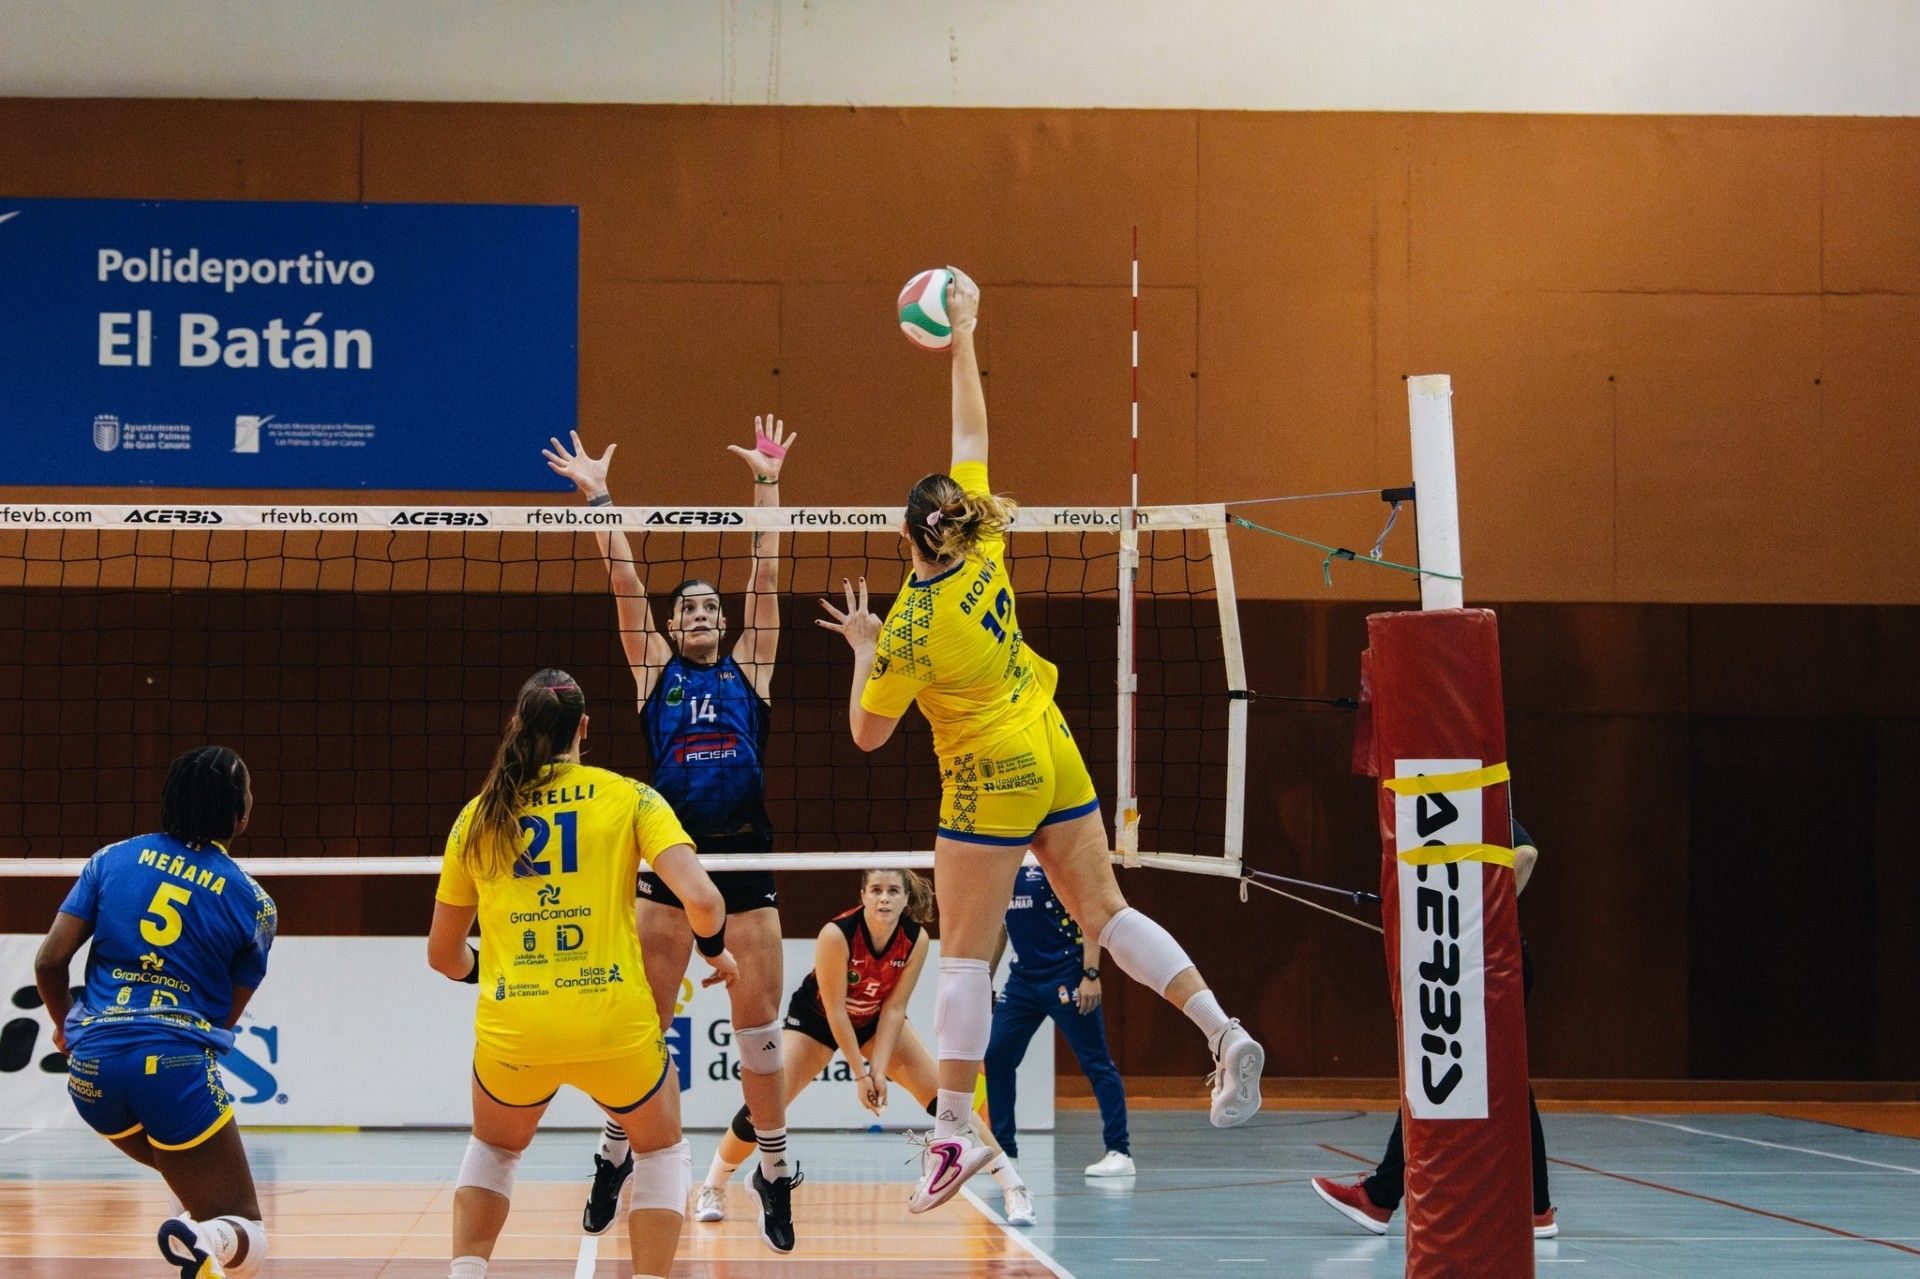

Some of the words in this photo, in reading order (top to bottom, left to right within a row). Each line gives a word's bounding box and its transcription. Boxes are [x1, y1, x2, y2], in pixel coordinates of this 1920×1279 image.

[98, 248, 375, 292] Polideportivo
[98, 310, 152, 366] El
[180, 312, 373, 369] Batán
[261, 507, 358, 524] rfevb.com
[526, 508, 622, 525] rfevb.com
[790, 508, 887, 526] rfevb.com
[1054, 509, 1148, 525] rfevb.cm
[690, 694, 717, 724] 14
[1014, 775, 1045, 788] ROQUE
[523, 784, 595, 807] RELLI
[512, 811, 578, 879] 21
[138, 849, 226, 896] MEÑANA
[140, 881, 192, 947] 5
[510, 905, 591, 924] GranCanaria
[112, 967, 191, 993] GranCanaria
[554, 975, 607, 988] Canarias
[580, 966, 606, 977] Islas
[508, 990, 517, 998] de
[517, 989, 549, 998] Canarias
[863, 982, 881, 997] 5
